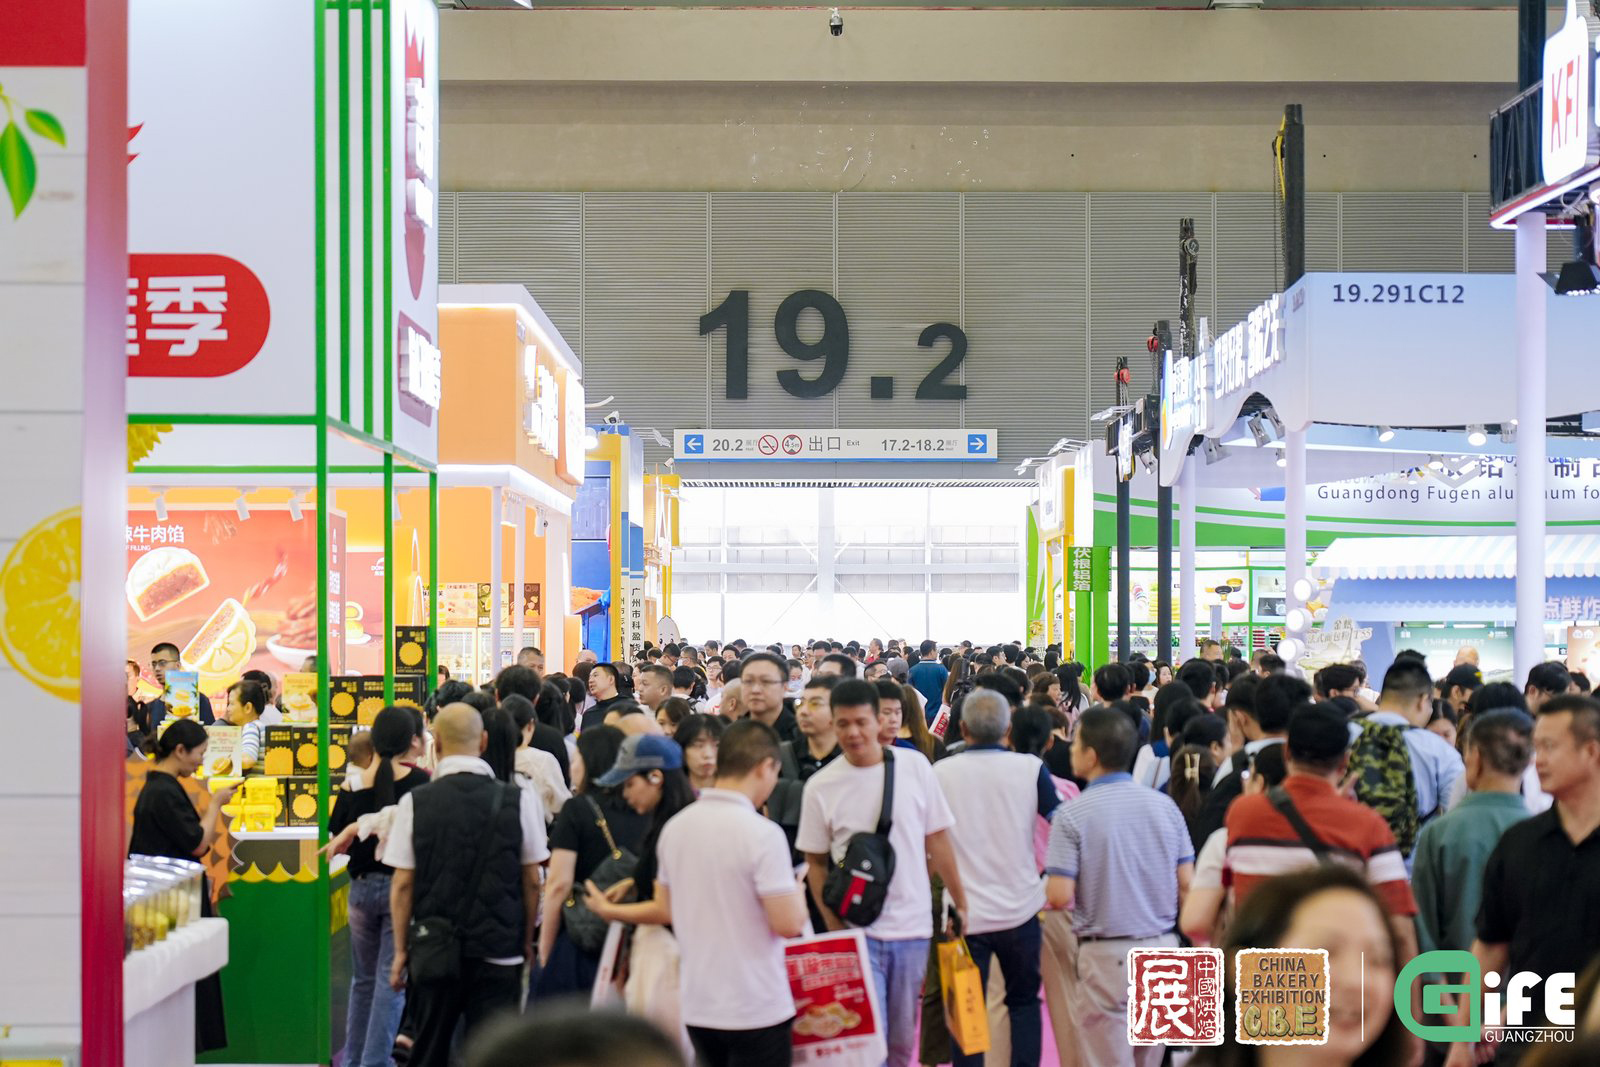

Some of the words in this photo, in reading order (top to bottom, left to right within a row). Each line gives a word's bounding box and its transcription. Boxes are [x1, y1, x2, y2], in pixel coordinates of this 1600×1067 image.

[1333, 283, 1465, 304] 19.291C12
[699, 289, 968, 401] 19.2
[712, 438, 744, 452] 20.2
[808, 435, 841, 452] 出口
[846, 439, 860, 447] Exit
[881, 438, 945, 452] 17.2-18.2
[1317, 485, 1420, 503] Guangdong
[1427, 485, 1481, 503] Fugen
[1073, 547, 1092, 591] 伏根铝箔
